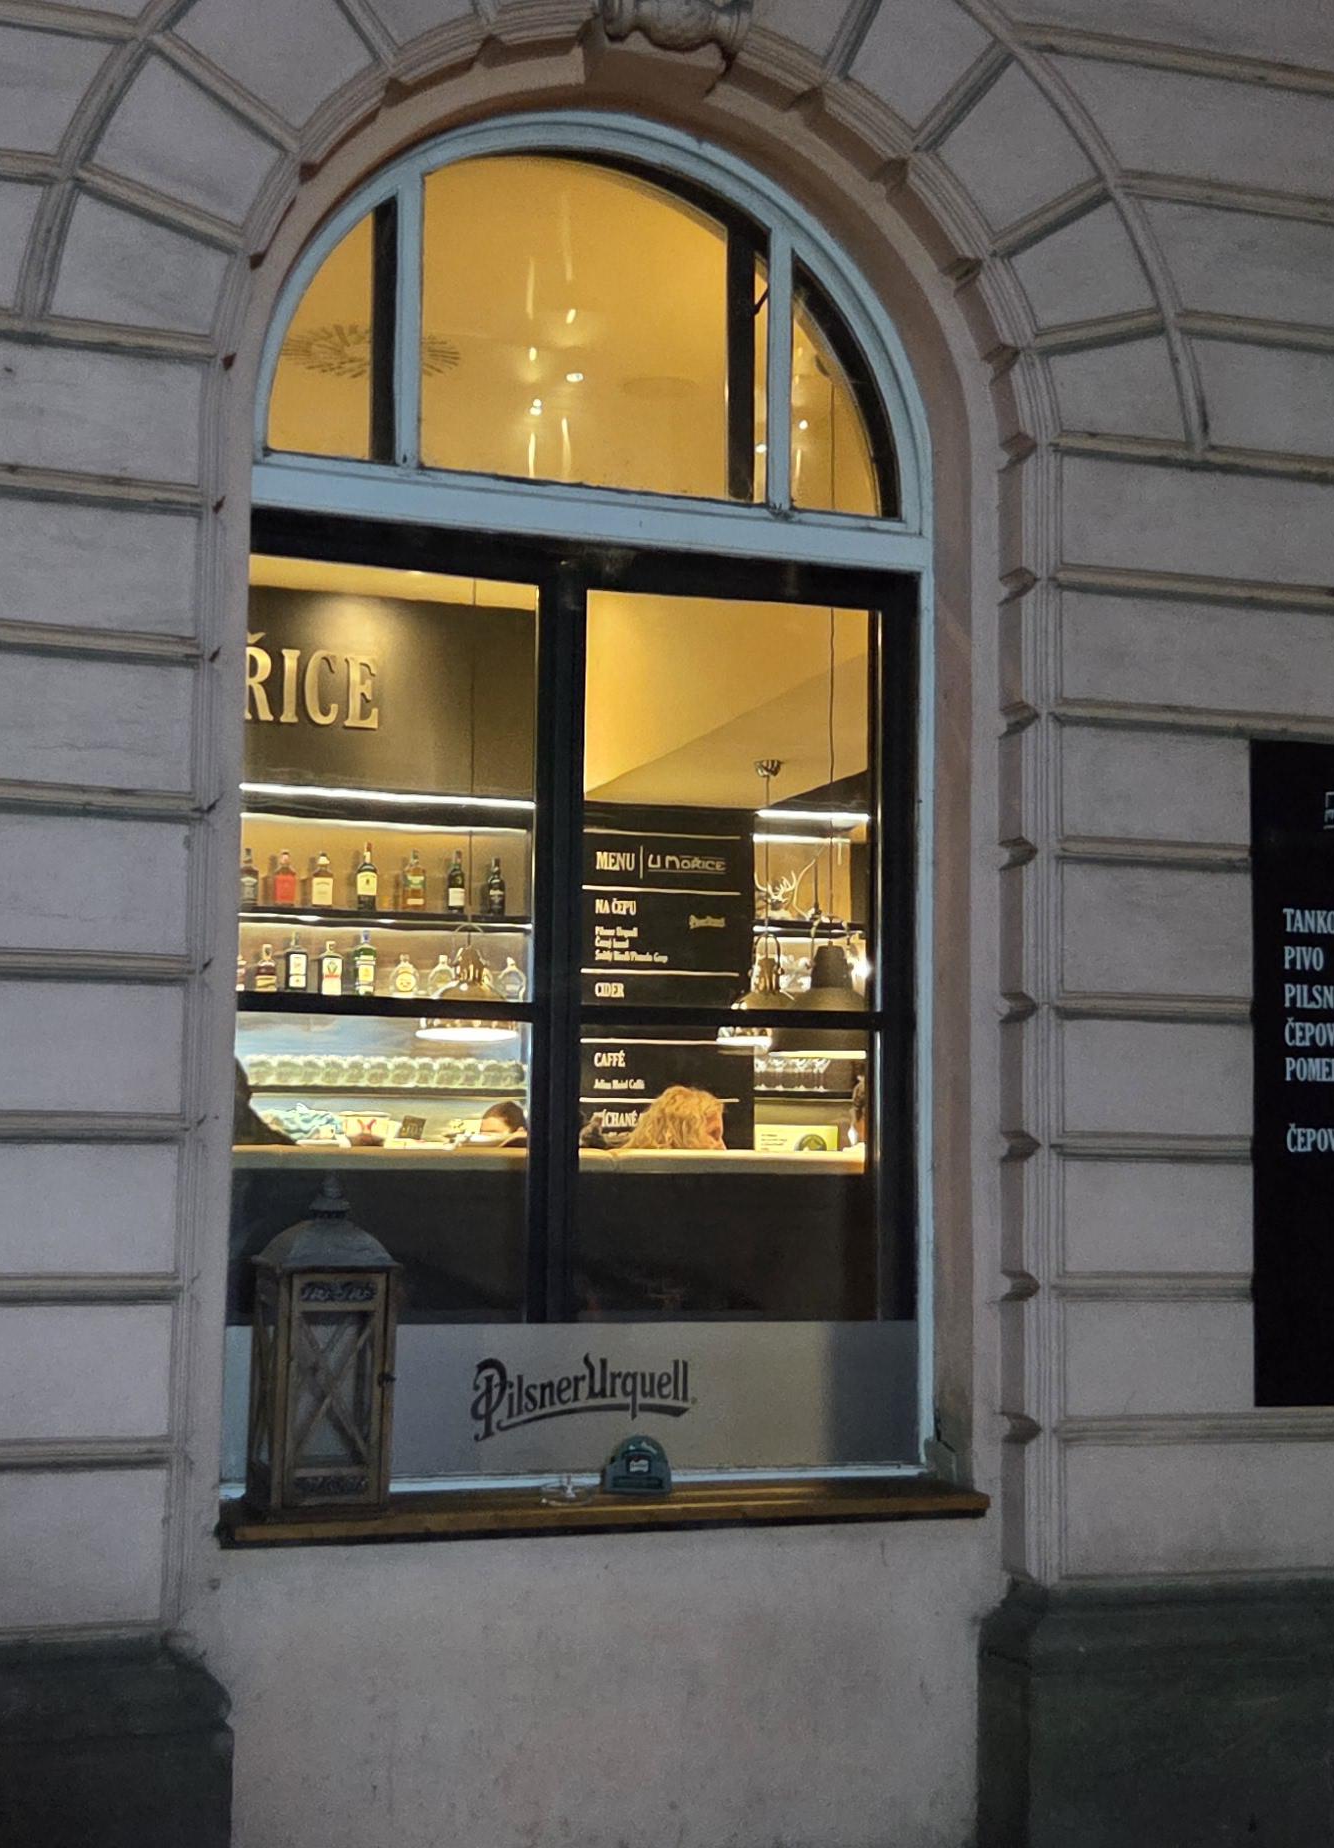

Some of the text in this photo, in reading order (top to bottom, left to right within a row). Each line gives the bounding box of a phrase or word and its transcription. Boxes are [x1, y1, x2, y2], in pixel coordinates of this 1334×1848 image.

[596, 851, 635, 872] MENU
[648, 855, 727, 872] U MOŘICE
[595, 897, 637, 916] NA ČEPU
[1284, 946, 1324, 972] PIVO
[594, 982, 625, 999] CIDER
[594, 1051, 626, 1068] CAFFÉ
[594, 1109, 638, 1128] ÍCHANÉ
[471, 1353, 688, 1442] Pilsner Urquell
